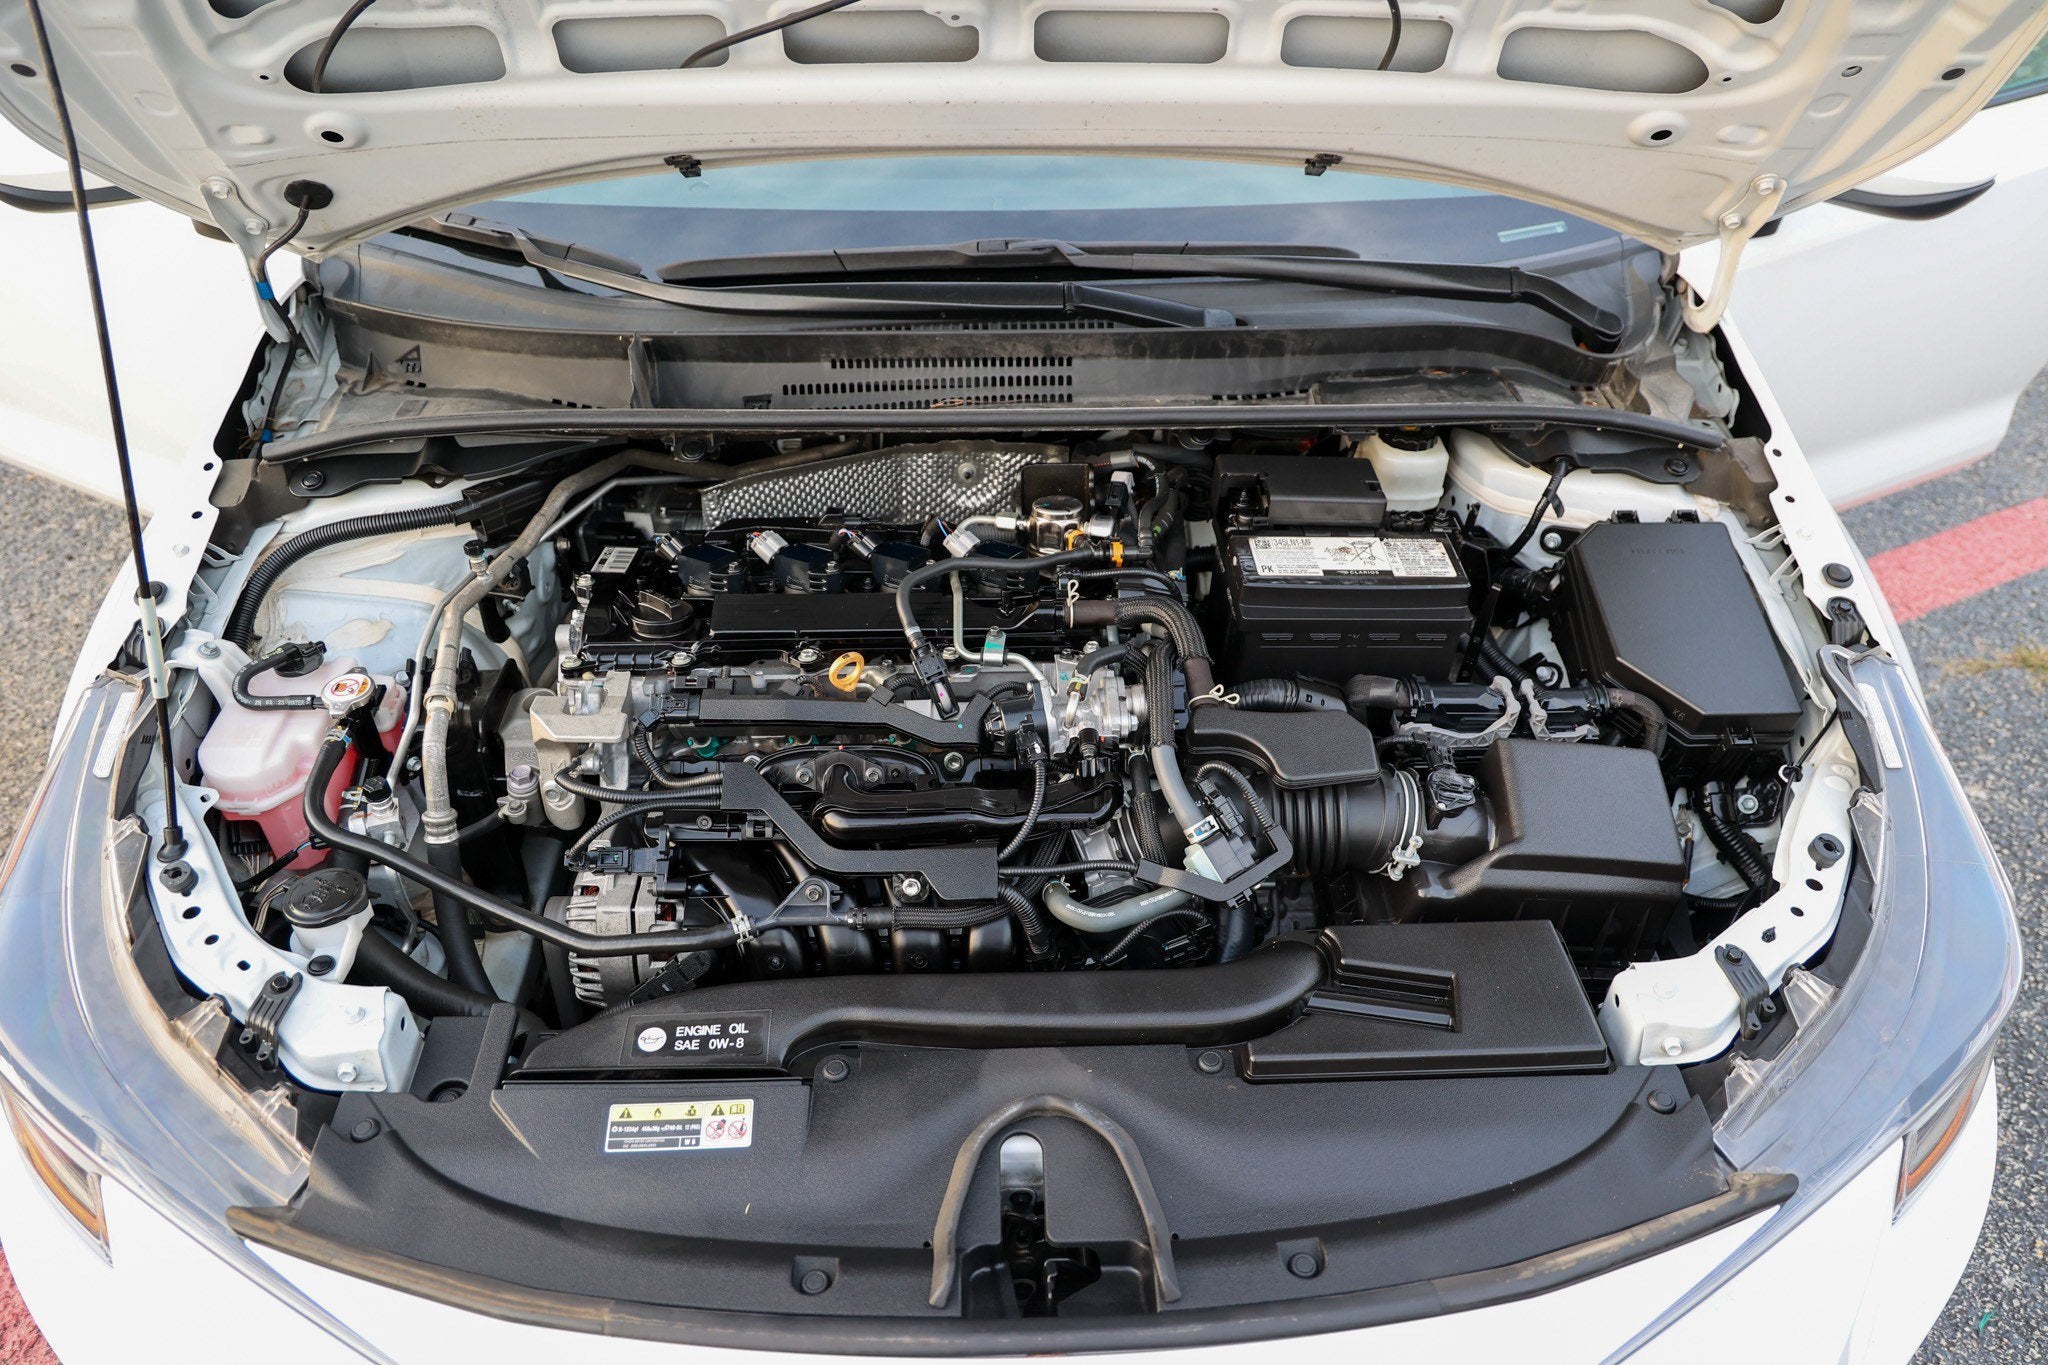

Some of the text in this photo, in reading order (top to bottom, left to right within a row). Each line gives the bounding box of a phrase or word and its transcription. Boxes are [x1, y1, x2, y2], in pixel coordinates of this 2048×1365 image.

[1261, 565, 1274, 573] PK
[675, 1022, 749, 1037] ENGINE OIL
[674, 1037, 745, 1051] SAE 0W-8
[684, 1138, 691, 1146] W
